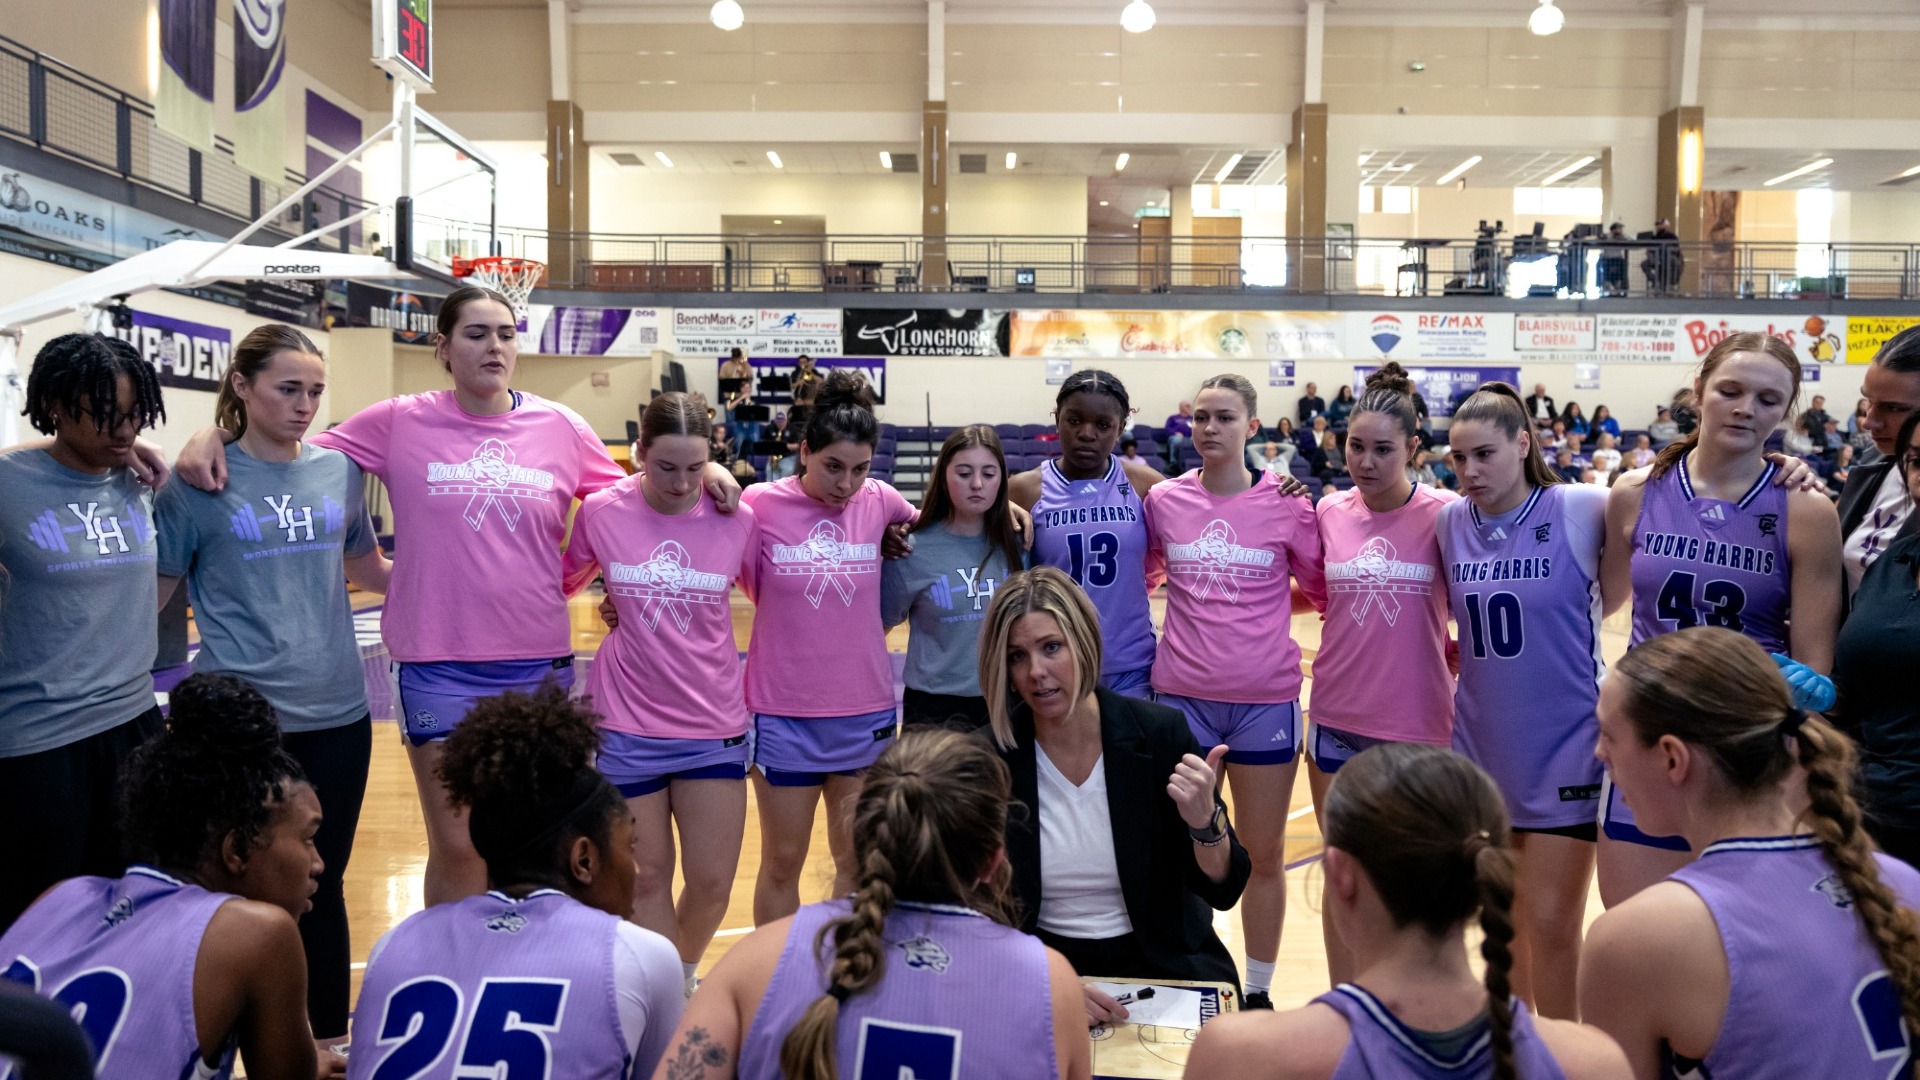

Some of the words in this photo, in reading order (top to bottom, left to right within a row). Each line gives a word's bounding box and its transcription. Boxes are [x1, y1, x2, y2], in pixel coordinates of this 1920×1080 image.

[401, 8, 425, 68] 30
[34, 200, 106, 231] OAKS
[677, 312, 737, 325] BenchMark
[760, 310, 780, 321] Pro
[1418, 315, 1484, 328] RE/MAX
[1518, 319, 1591, 331] BLAIRSVILLE
[677, 338, 703, 346] Young
[736, 338, 748, 346] GA
[823, 338, 837, 346] GA
[900, 329, 991, 346] LONGHORN
[1532, 334, 1577, 346] CINEMA
[172, 332, 231, 381] DEN
[900, 347, 992, 356] STEAKHOUSE
[1452, 373, 1478, 382] LION
[428, 463, 474, 480] YOUNG
[509, 464, 554, 488] HARRIS
[66, 501, 131, 555] YH
[263, 493, 316, 543] YH
[1045, 508, 1086, 529] YOUNG
[1090, 505, 1137, 523] HARRIS
[243, 548, 279, 560] SPORTS
[773, 545, 811, 562] YOUNG
[841, 543, 877, 561] HARRIS
[1066, 531, 1120, 588] 13
[1228, 545, 1274, 566] HARRIS
[1644, 532, 1699, 561] YOUNG
[1703, 540, 1775, 576] HARRIS
[47, 560, 91, 573] SPORTS
[610, 563, 650, 583] YOUNG
[681, 569, 727, 591] HARRIS
[1388, 561, 1435, 582] HARRIS
[1451, 561, 1489, 585] YOUNG
[1491, 557, 1550, 582] HARRIS
[956, 566, 995, 611] YH
[1656, 569, 1747, 632] 43
[1464, 591, 1525, 660] 10
[371, 975, 571, 1080] 25
